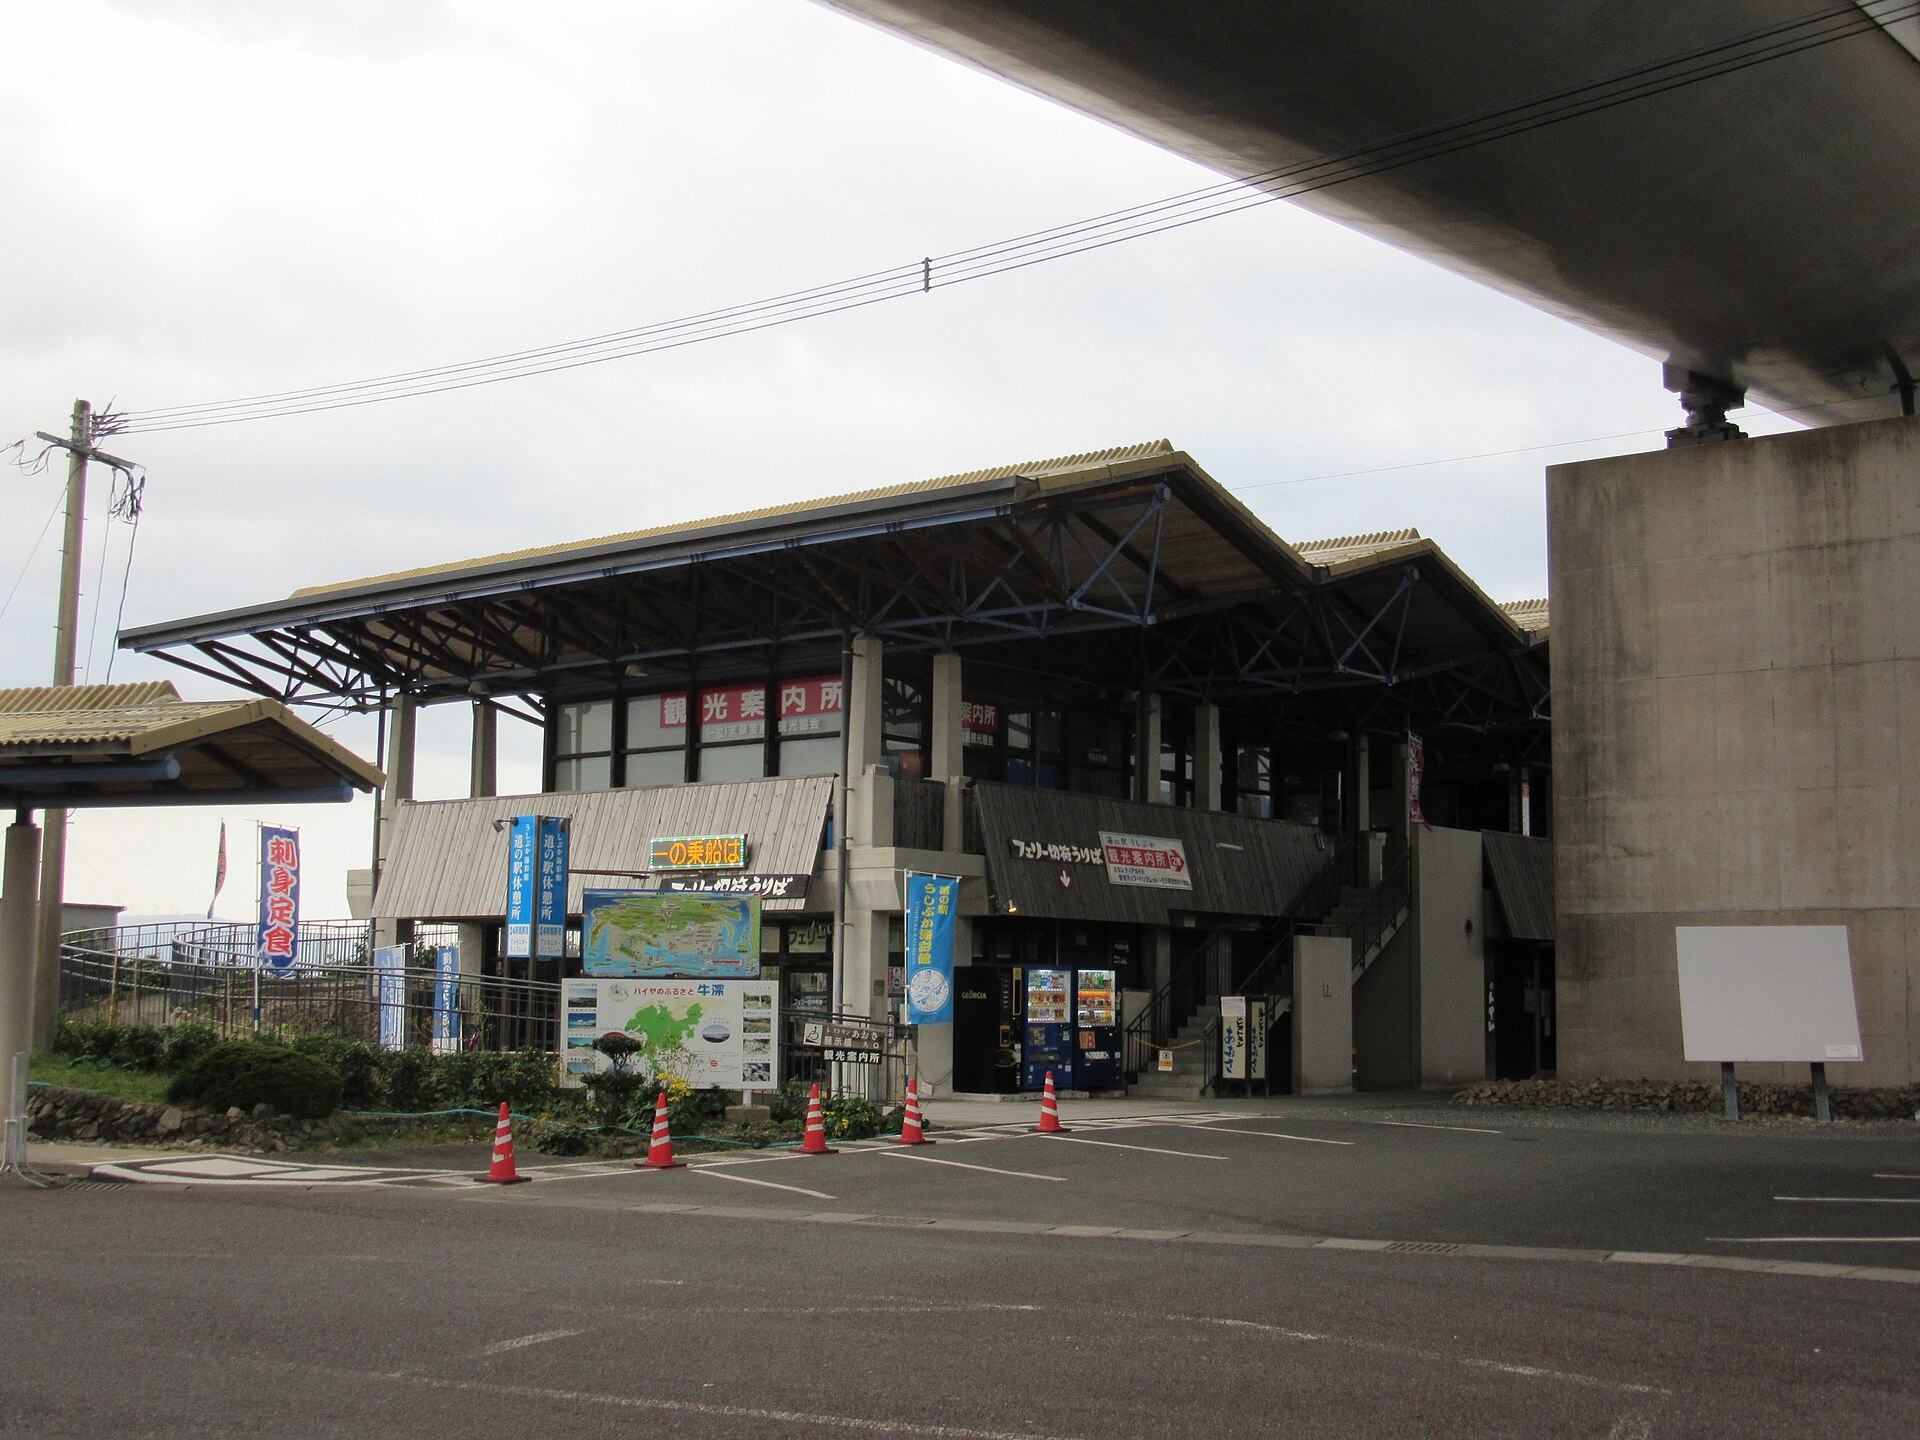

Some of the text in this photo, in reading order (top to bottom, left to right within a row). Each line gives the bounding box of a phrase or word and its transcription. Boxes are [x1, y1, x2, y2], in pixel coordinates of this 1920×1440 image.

[664, 681, 842, 725] 観光案内所
[1011, 838, 1104, 865] フェリー切符うりば
[1107, 847, 1166, 867] 観光案内所
[510, 834, 524, 921] 道の駅休憩所
[541, 834, 555, 921] 道の駅休憩所
[671, 876, 794, 896] リー切符うりば
[265, 837, 298, 956] 刺身定食
[634, 983, 725, 997] ハイヤのふるさと 牛深
[852, 1030, 879, 1041] あおさ
[862, 1041, 879, 1049] 入口
[824, 1049, 880, 1064] 観光案内所
